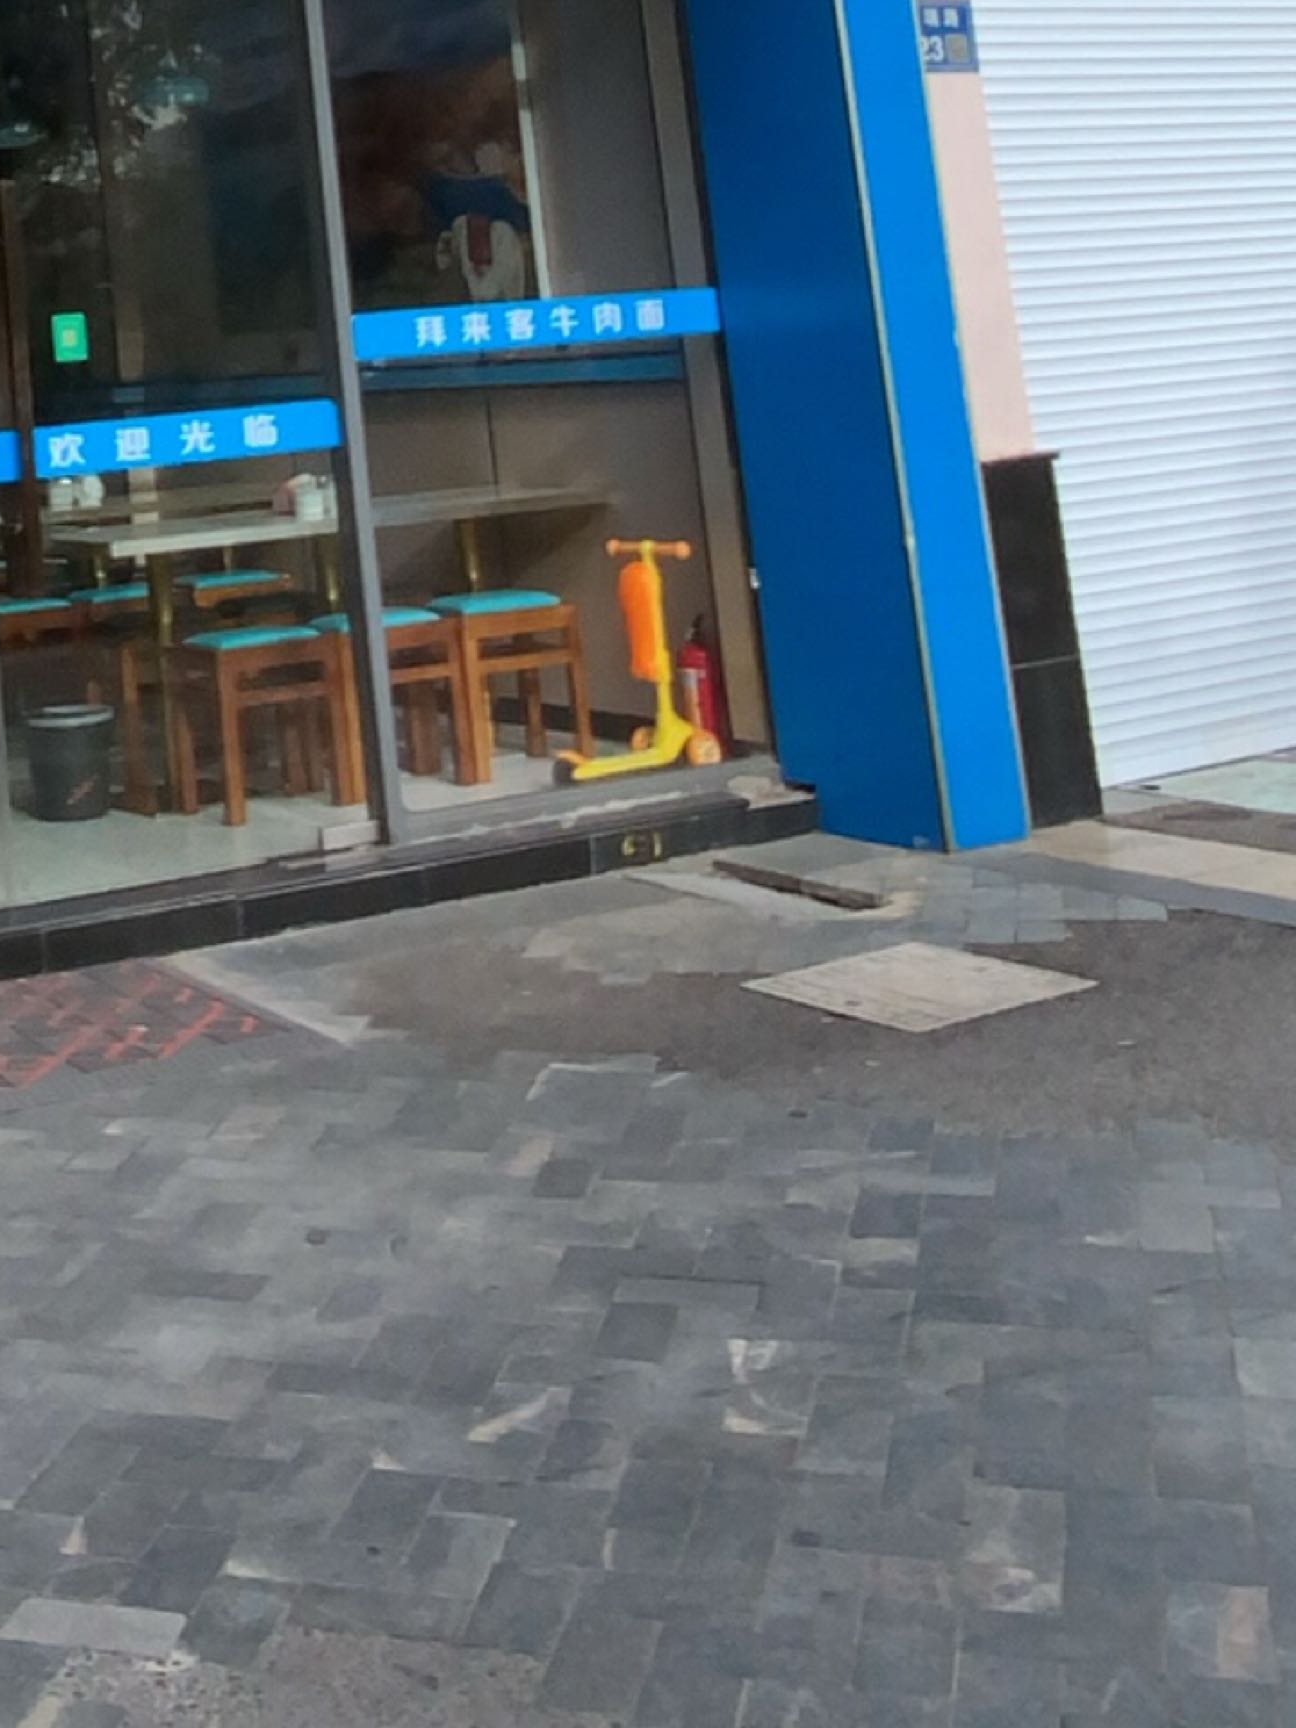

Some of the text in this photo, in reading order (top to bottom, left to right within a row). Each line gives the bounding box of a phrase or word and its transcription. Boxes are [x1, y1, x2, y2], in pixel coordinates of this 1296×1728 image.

[414, 298, 666, 349] 拜来客牛肉面
[48, 413, 280, 470] 欢迎光临
